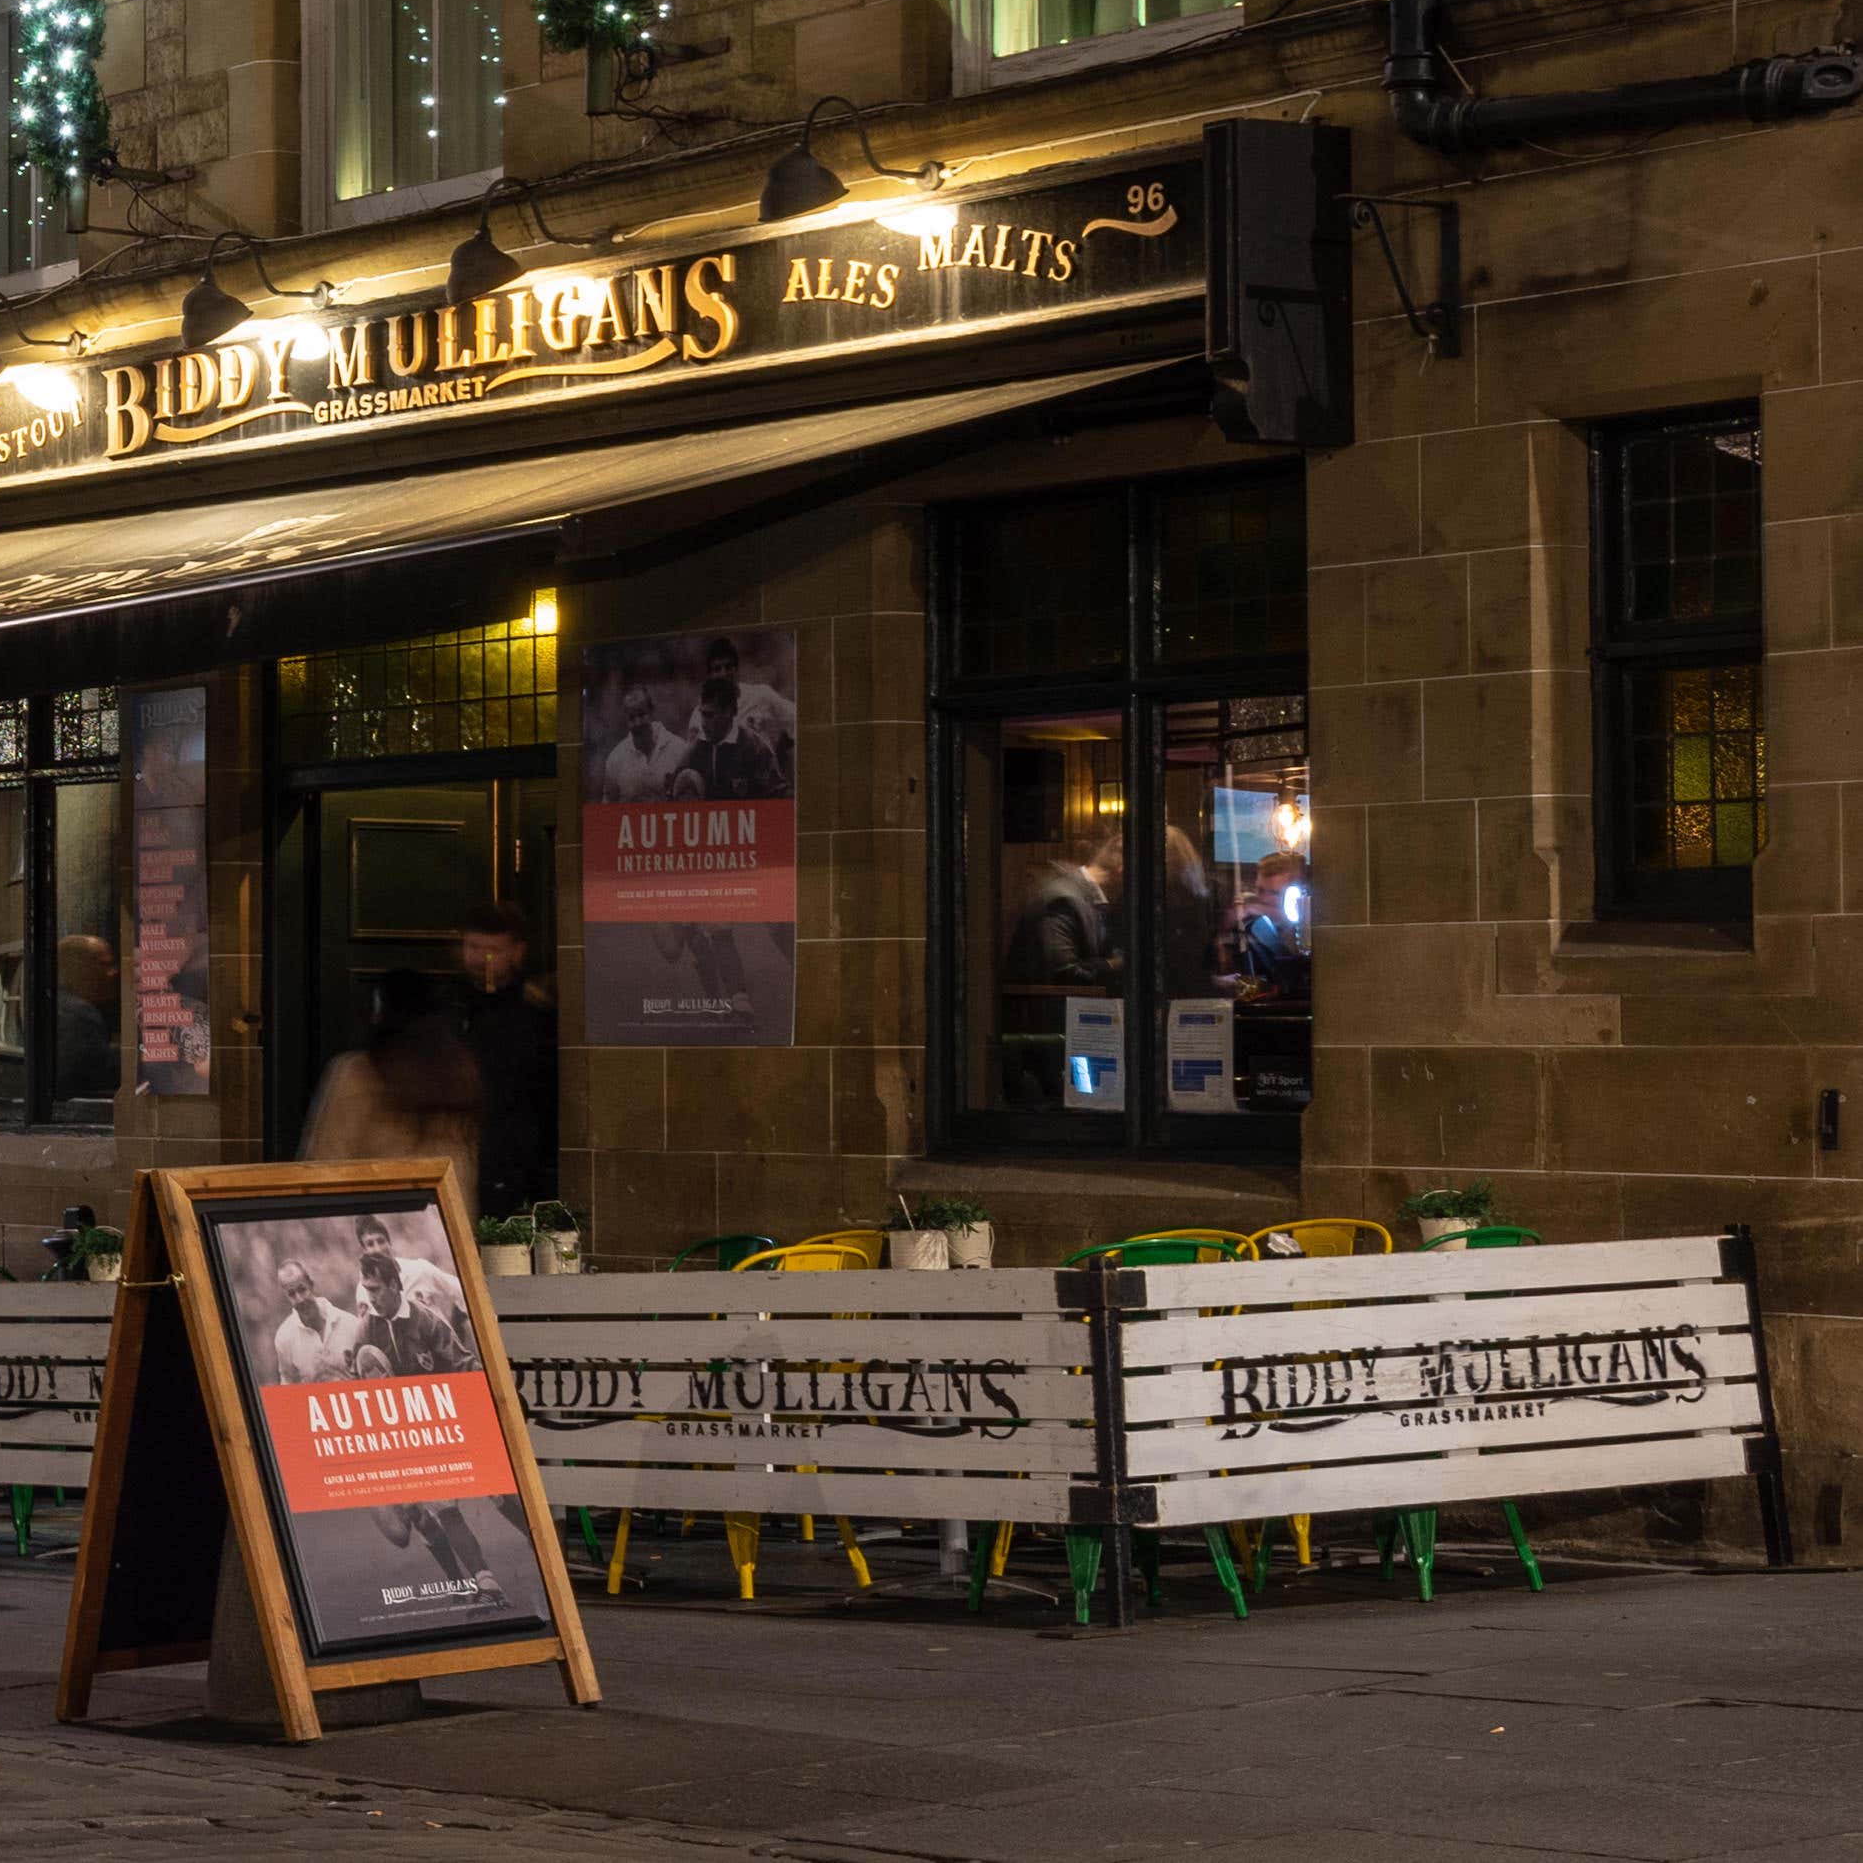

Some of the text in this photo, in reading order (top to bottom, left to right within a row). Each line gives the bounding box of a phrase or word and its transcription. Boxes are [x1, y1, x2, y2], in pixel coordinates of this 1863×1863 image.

[1126, 182, 1166, 215] 96
[917, 223, 1077, 282] MALTS
[782, 257, 901, 310] ALES
[101, 254, 740, 459] BIDDY MULLIGANS
[313, 376, 487, 425] GRASSMARKET
[617, 810, 757, 849] AUTUMN
[617, 851, 758, 873] INTERNATIONALS
[141, 960, 179, 971] CORNER
[142, 977, 168, 987] SHOP
[143, 995, 179, 1007] HEARTY
[643, 997, 732, 1014] BIDDY MULLIGANS
[144, 1011, 193, 1024] IRISH FOOD
[145, 1032, 168, 1044] TRAD
[145, 1047, 178, 1058] NIGHTS
[1279, 1076, 1304, 1086] Sport
[1220, 1324, 1708, 1440] BIDDY MULLIGANS
[307, 1382, 459, 1434] AUTUMN
[683, 1357, 1030, 1439] MULLIGANS
[1399, 1401, 1547, 1428] GRASSMARKET
[313, 1424, 466, 1458] INTERNATIONALS
[665, 1421, 826, 1438] GRASSMARKET
[379, 1469, 400, 1480] RUGBY
[401, 1466, 424, 1477] ACTION
[424, 1465, 439, 1475] LIVE
[381, 1577, 478, 1605] BIDDY MULLIGANS
